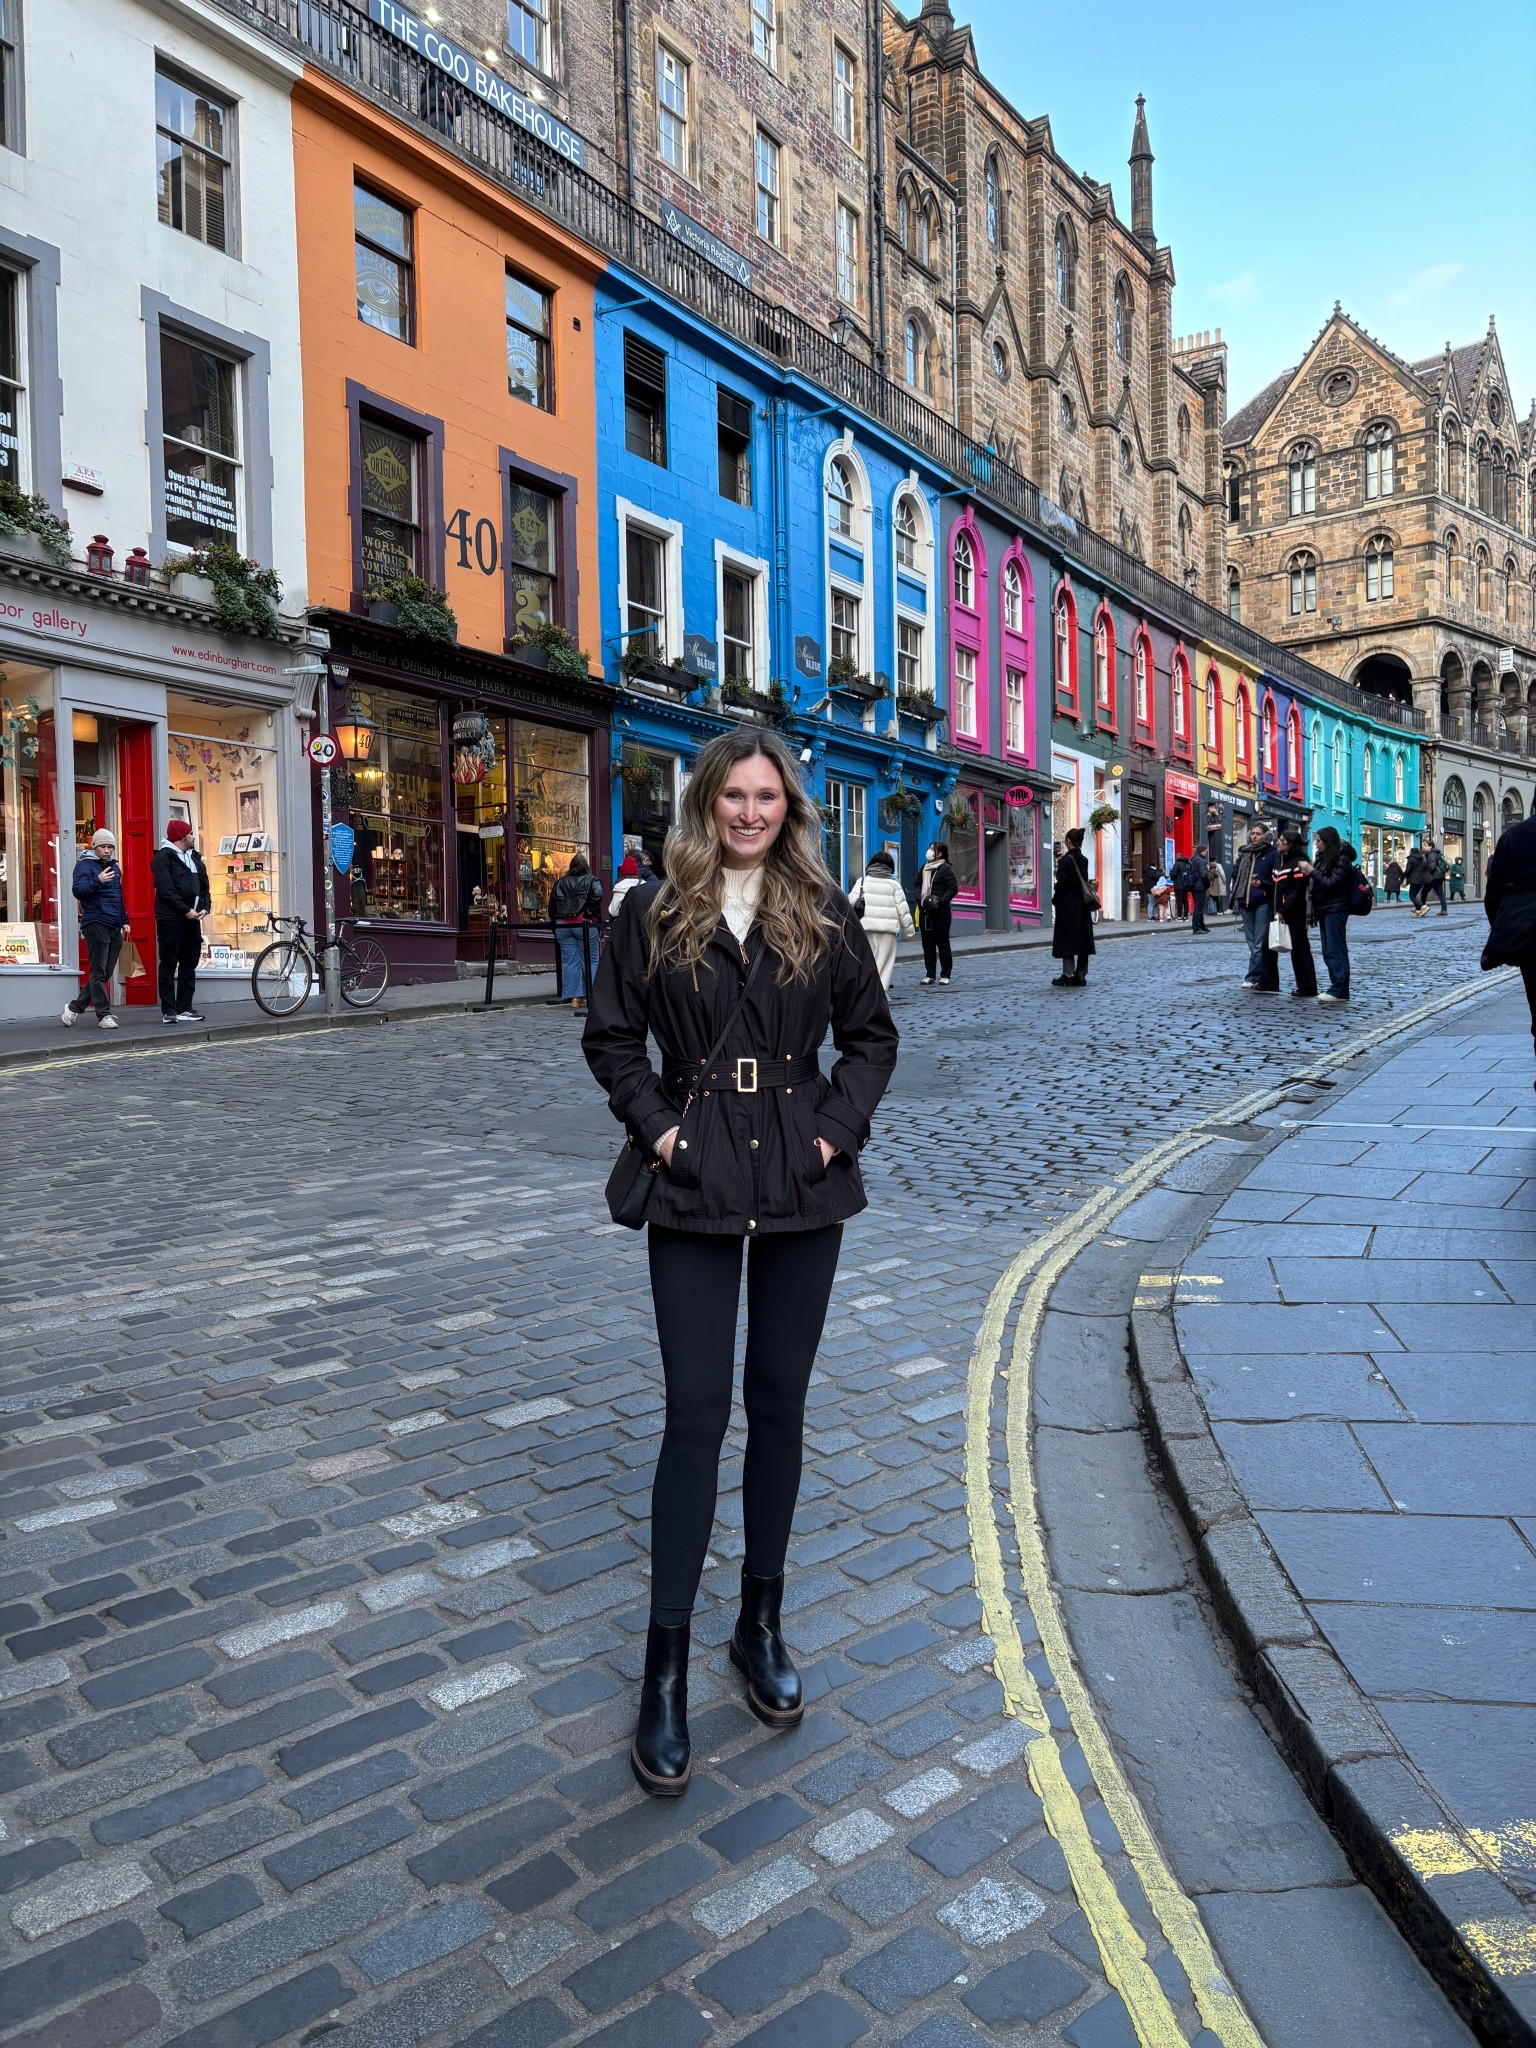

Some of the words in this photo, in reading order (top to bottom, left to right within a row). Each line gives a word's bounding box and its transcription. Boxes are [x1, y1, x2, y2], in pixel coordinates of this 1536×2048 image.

[378, 0, 419, 49] THE
[424, 34, 469, 83] COO
[475, 67, 580, 165] BAKEHOUSE
[685, 224, 710, 250] Victoria
[710, 244, 734, 268] Regalia
[370, 456, 404, 482] ORIGINAL
[168, 469, 186, 482] Over
[186, 474, 200, 488] 150
[201, 480, 226, 496] Artists!
[174, 482, 198, 499] Prints,
[199, 491, 234, 511] Jewellery,
[192, 511, 209, 524] Gifts
[210, 518, 215, 527] &
[216, 519, 237, 534] Cards
[197, 502, 234, 521] Homeware
[520, 517, 540, 534] BEST
[364, 535, 405, 555] WORLD
[446, 508, 498, 576] 40
[362, 547, 406, 567] FAMOUS
[32, 610, 88, 637] gallery
[172, 645, 277, 675] www.edinburghart.com
[696, 656, 716, 672] BLEUE
[806, 658, 821, 672] BLEUE
[352, 645, 386, 664] Retailer
[389, 658, 398, 667] of
[401, 660, 442, 680] Officially
[444, 670, 477, 687] Licensed
[481, 679, 512, 696] HARRY
[513, 687, 549, 706] POTTER
[550, 696, 593, 716] Merchandise
[359, 734, 370, 749] 40
[360, 770, 430, 802] MUSEUM
[1210, 790, 1219, 800] THE
[528, 797, 580, 826] MUSEUM
